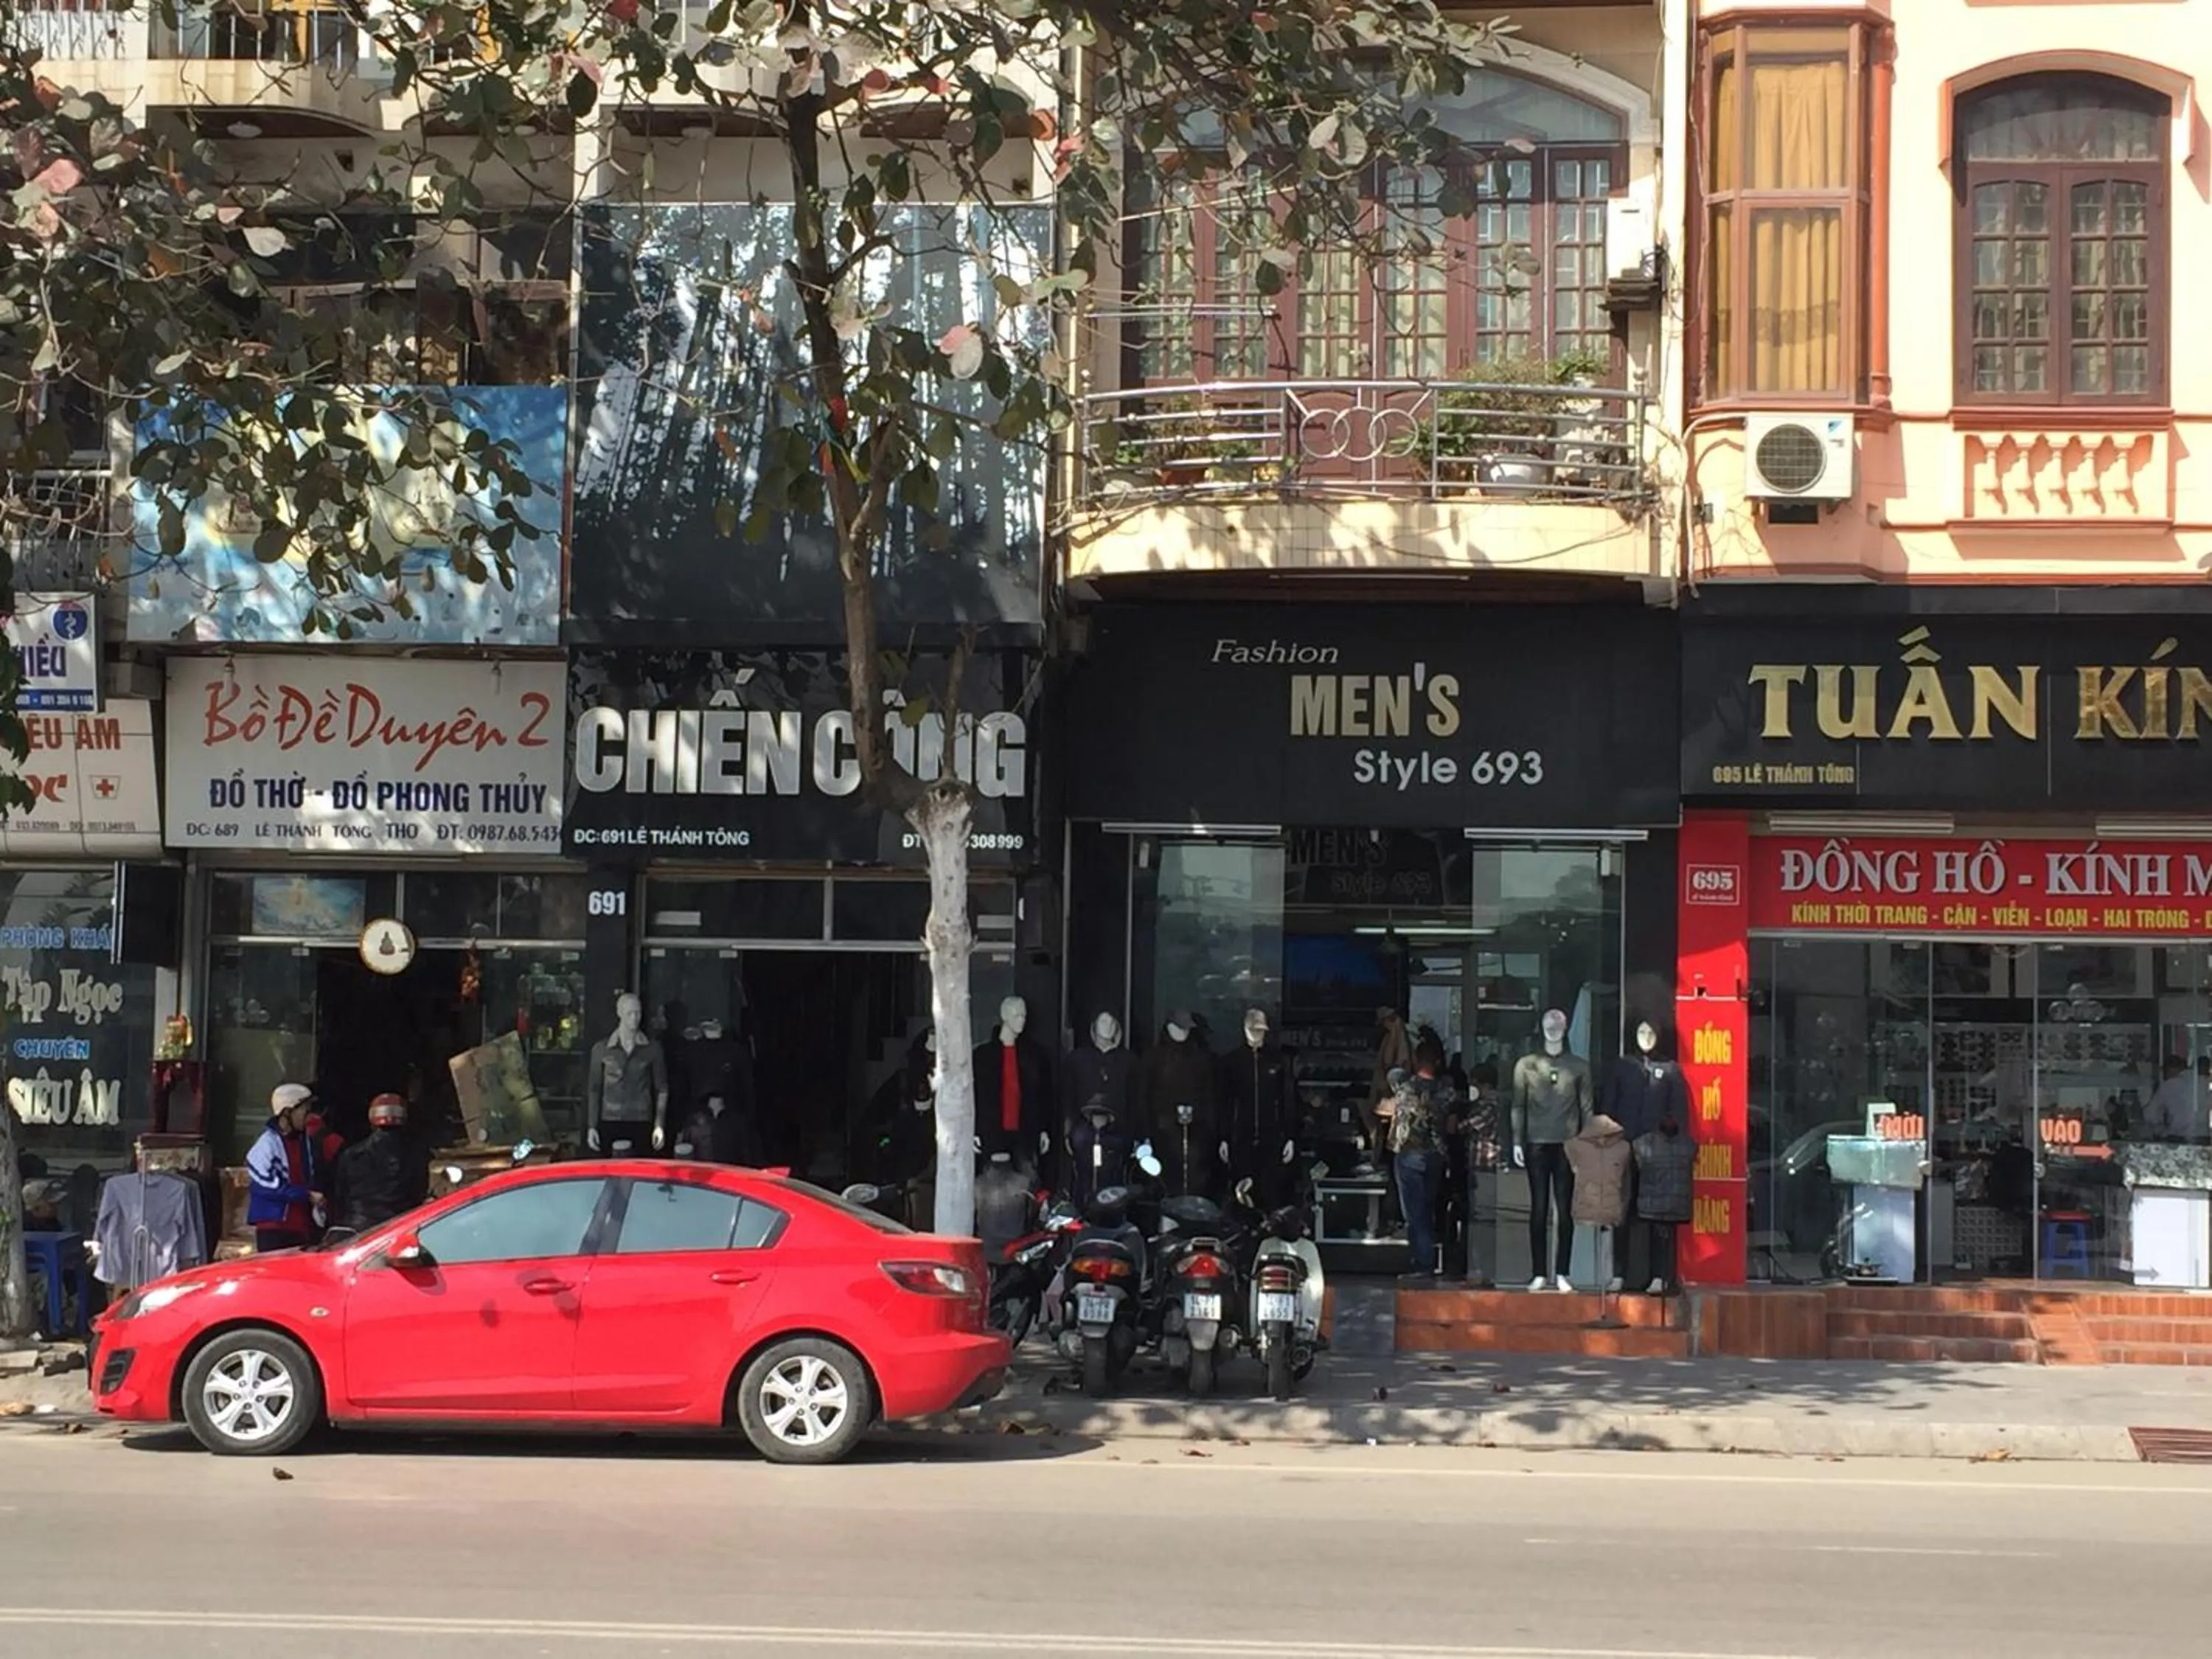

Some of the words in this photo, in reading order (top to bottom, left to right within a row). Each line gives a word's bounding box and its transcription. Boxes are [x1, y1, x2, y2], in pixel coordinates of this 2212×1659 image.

[1211, 639, 1339, 664] Fashion
[1290, 662, 1461, 737] MEN'S
[1747, 625, 2040, 740] TUẤN
[518, 692, 551, 746] 2
[575, 668, 801, 794] CHIẾN
[1354, 749, 1458, 790] Style
[1472, 751, 1543, 785] 693
[377, 782, 470, 813] PHONG
[479, 773, 547, 814] THỦY
[1693, 872, 1733, 890] 695
[1781, 837, 1920, 893] ĐỒNG
[1932, 840, 2006, 894] HỒ
[2045, 841, 2171, 896] KÍNH
[588, 891, 625, 915] 691
[1792, 901, 1830, 922] KÍNH
[1875, 905, 1927, 924] TRANG
[2104, 910, 2130, 928] HAI
[71, 923, 113, 949] KHÁ
[58, 969, 122, 1025] Ngọc
